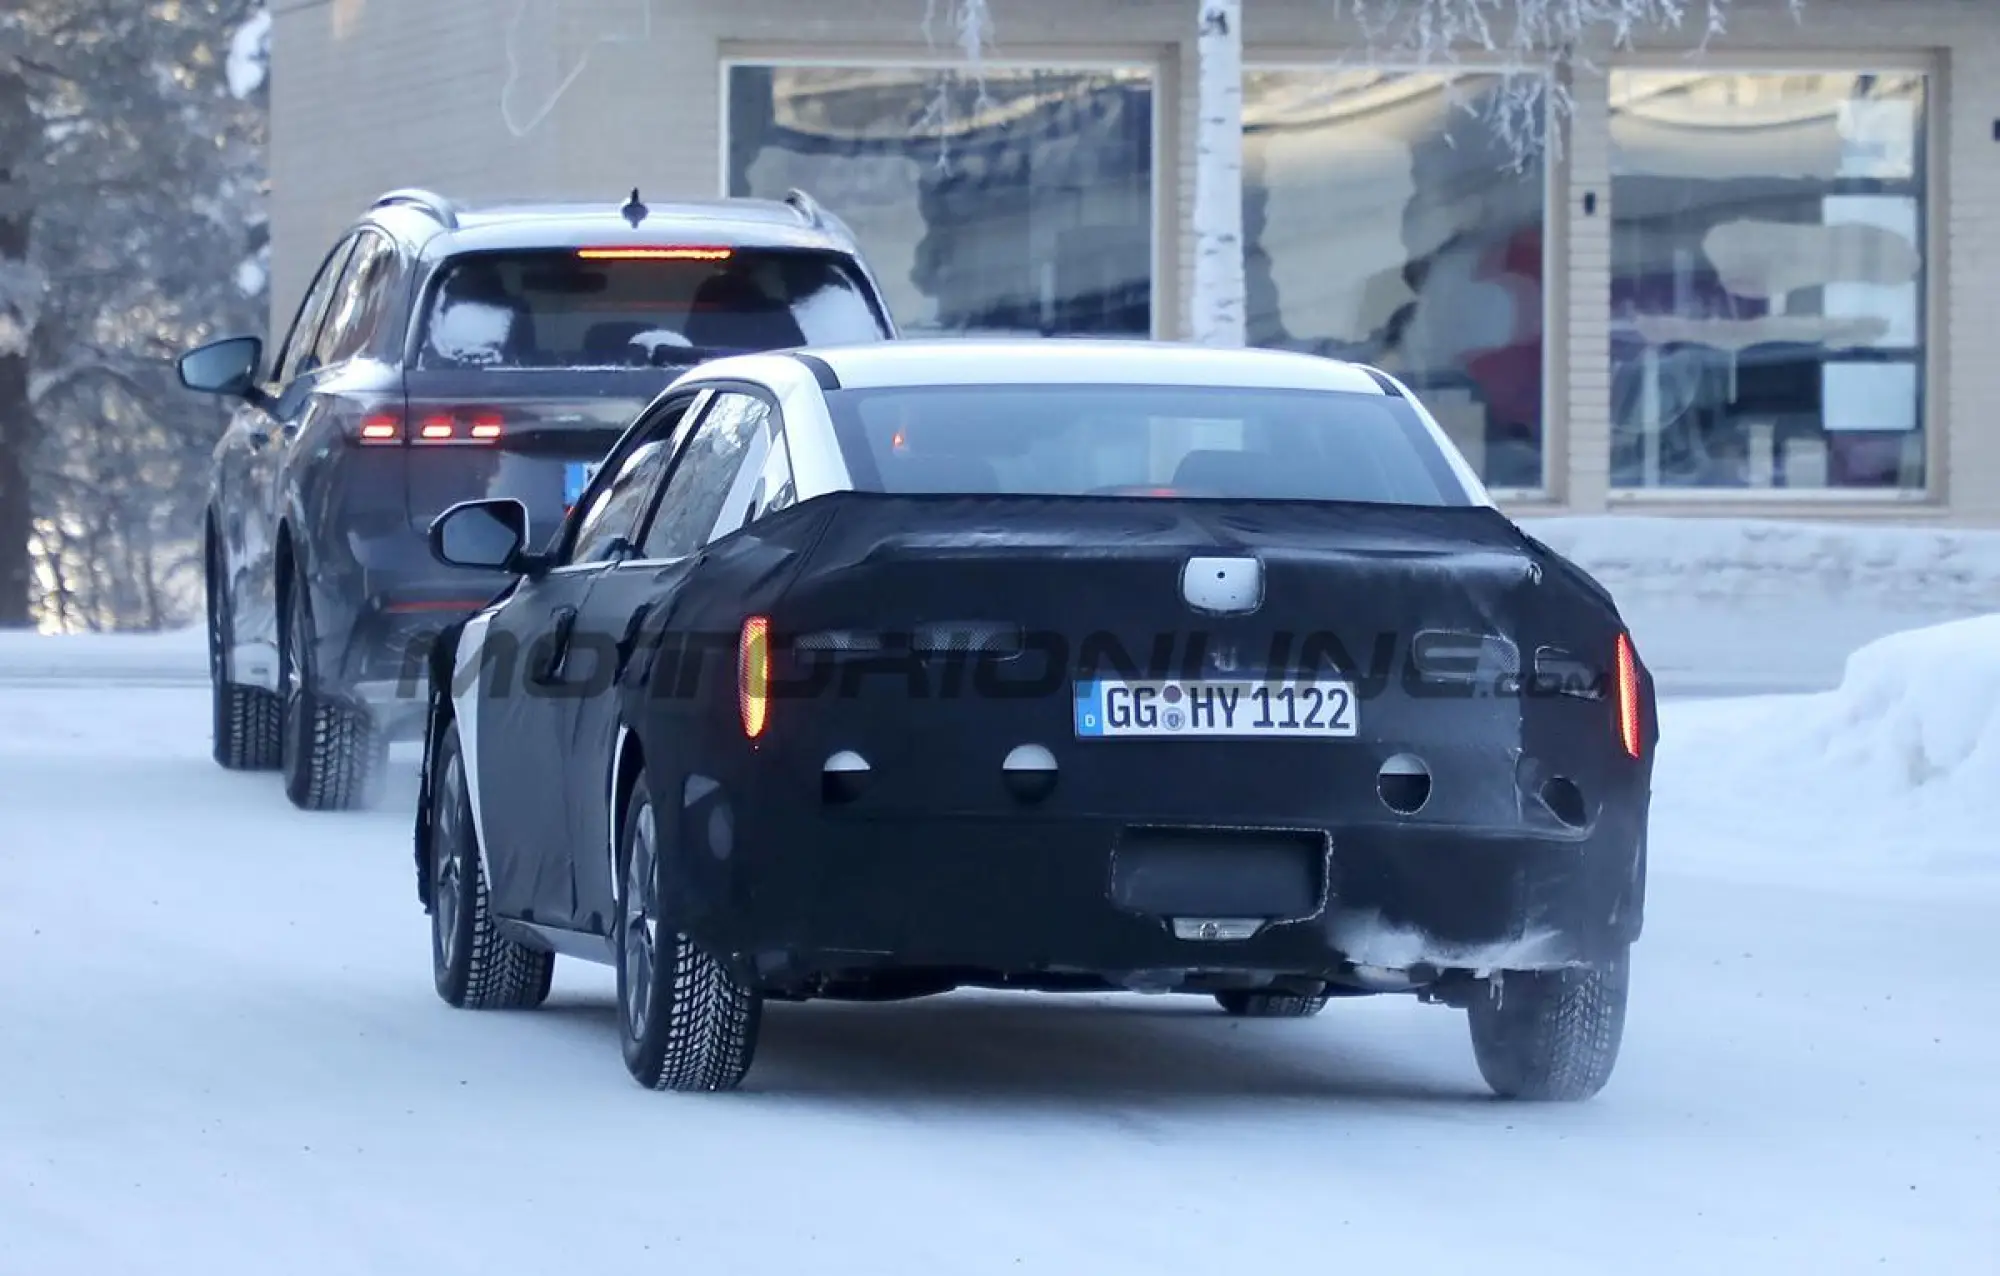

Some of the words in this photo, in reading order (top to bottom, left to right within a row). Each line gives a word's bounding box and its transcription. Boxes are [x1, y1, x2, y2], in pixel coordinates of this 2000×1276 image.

[1106, 686, 1158, 729] GG
[1190, 686, 1239, 729] HY
[1252, 686, 1351, 729] 1122
